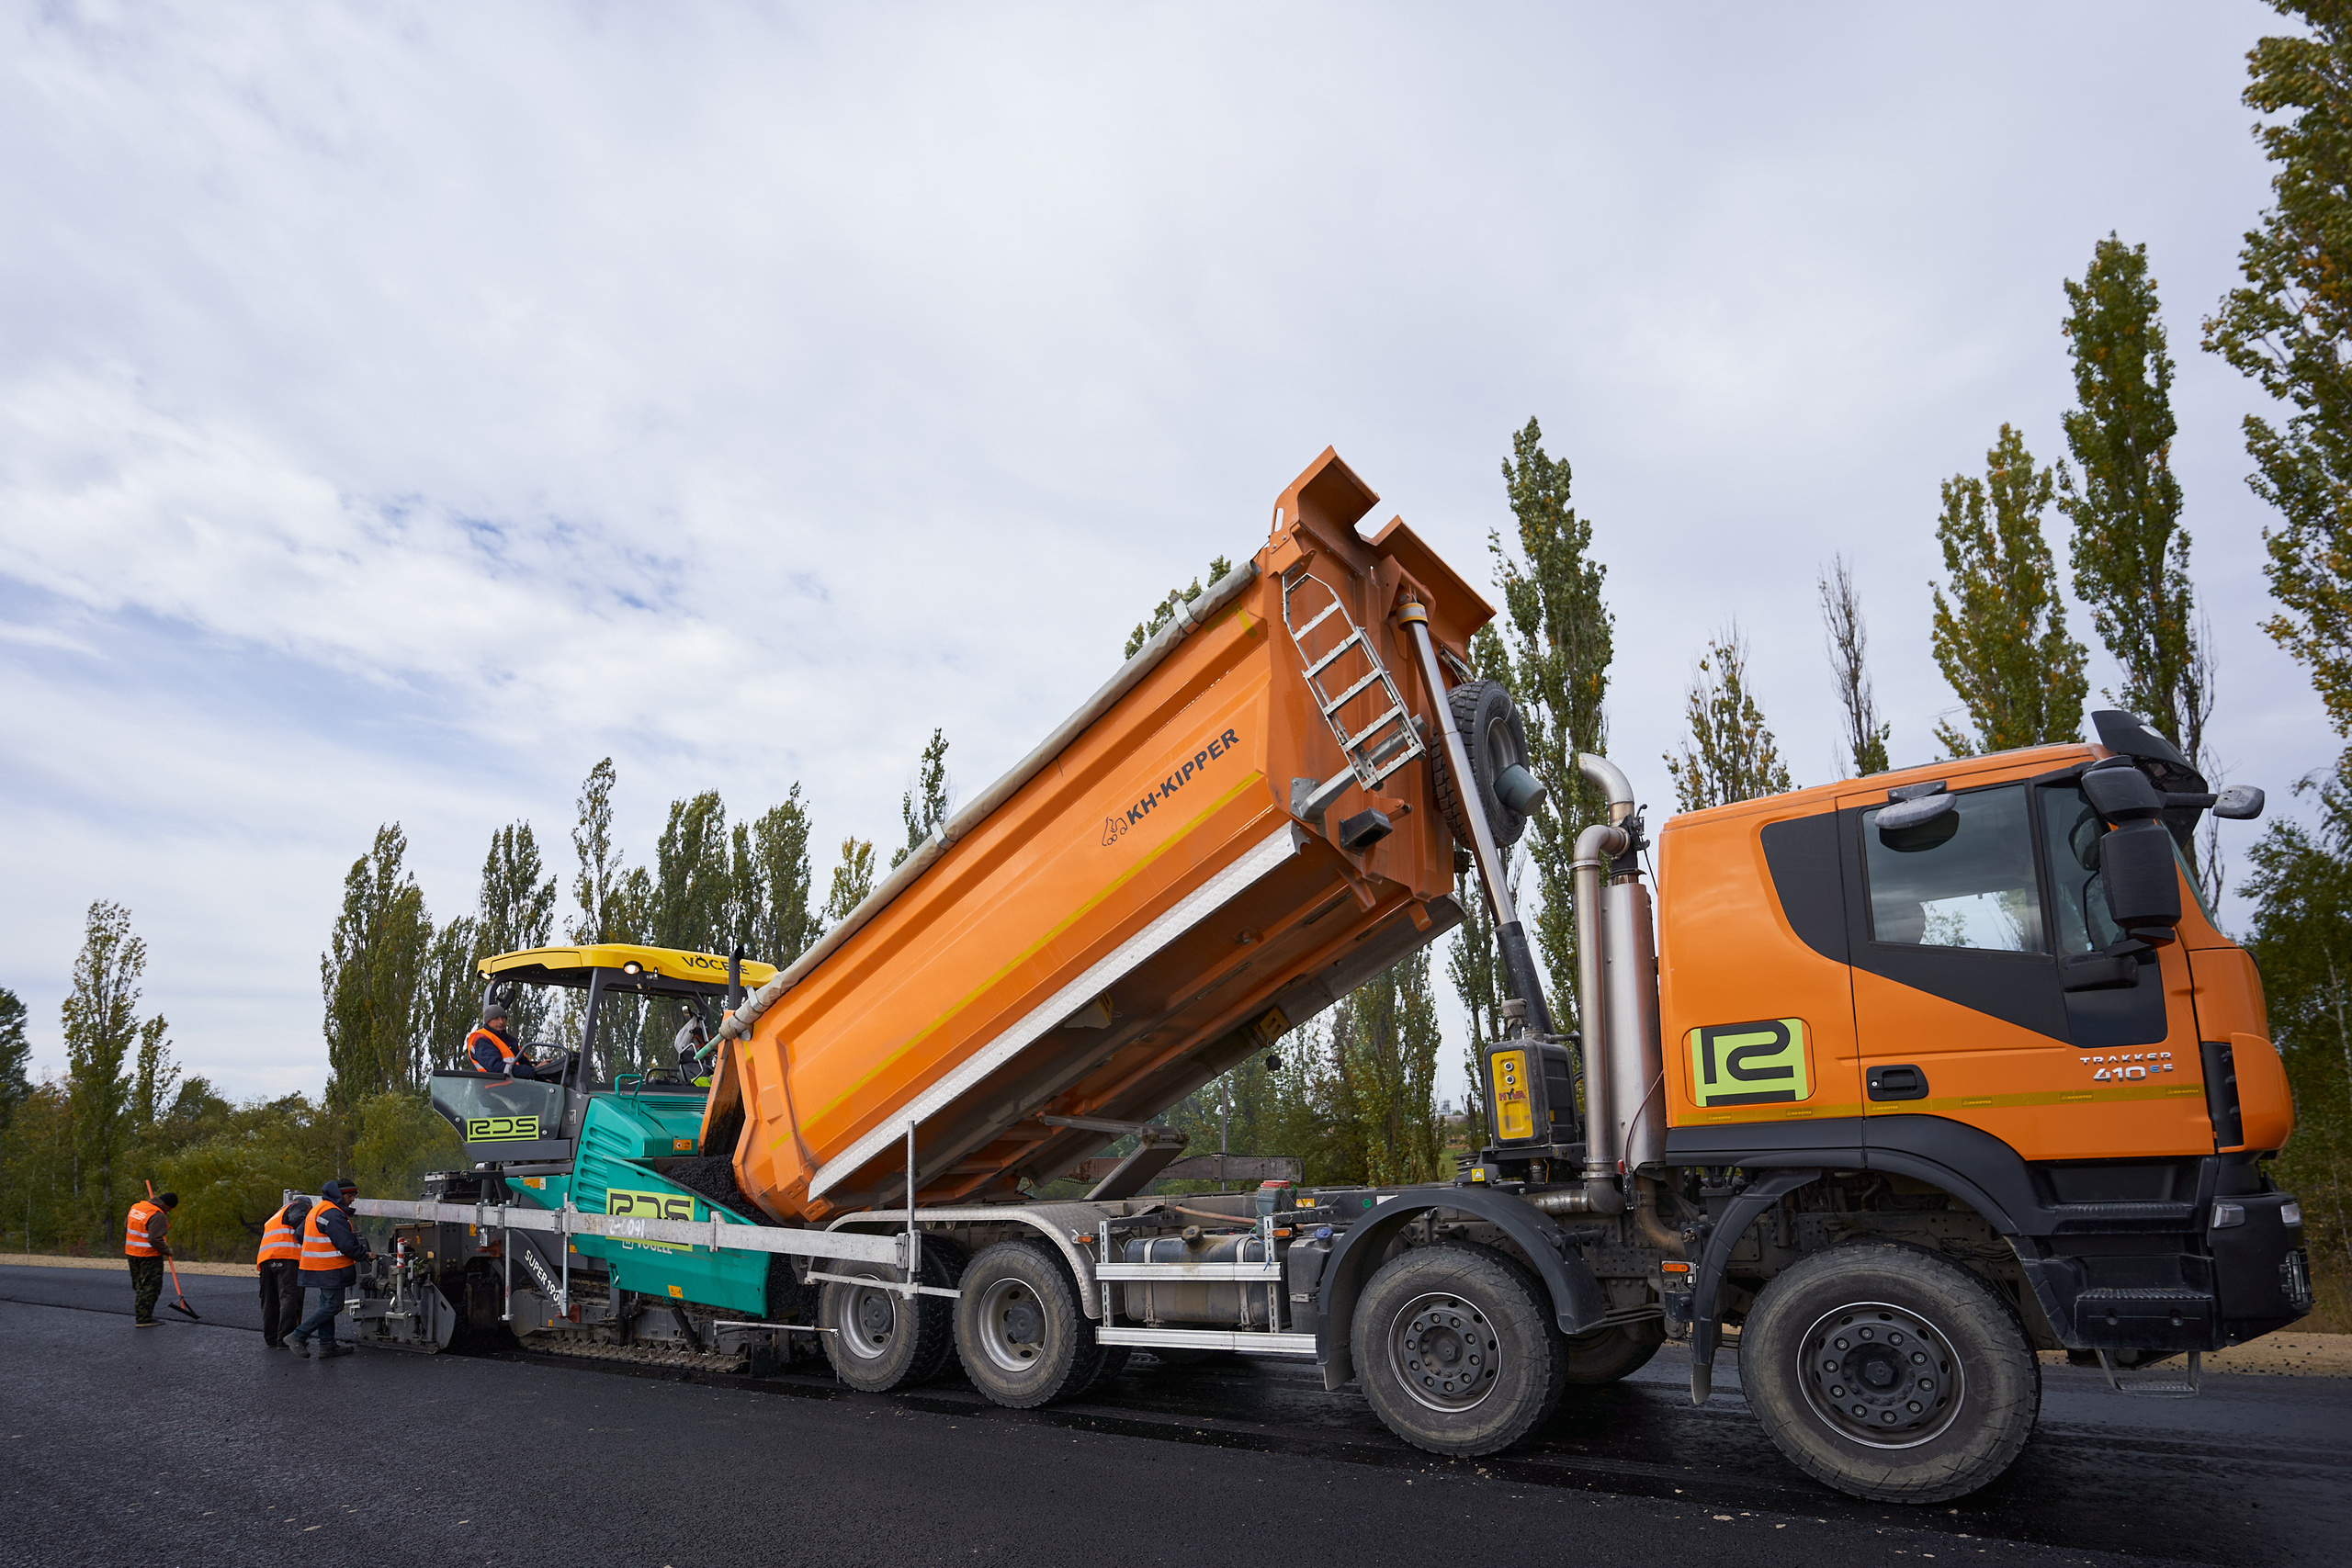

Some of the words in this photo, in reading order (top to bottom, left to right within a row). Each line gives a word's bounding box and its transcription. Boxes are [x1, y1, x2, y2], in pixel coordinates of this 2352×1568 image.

[1126, 728, 1239, 825] KH-KIPPER
[682, 955, 750, 976] VÖGEE
[2080, 1052, 2172, 1065] TRAKKER
[2093, 1066, 2146, 1082] 410
[1498, 1088, 1526, 1101] HYVA
[469, 1118, 537, 1135] RDS
[525, 1249, 548, 1285] SUPER
